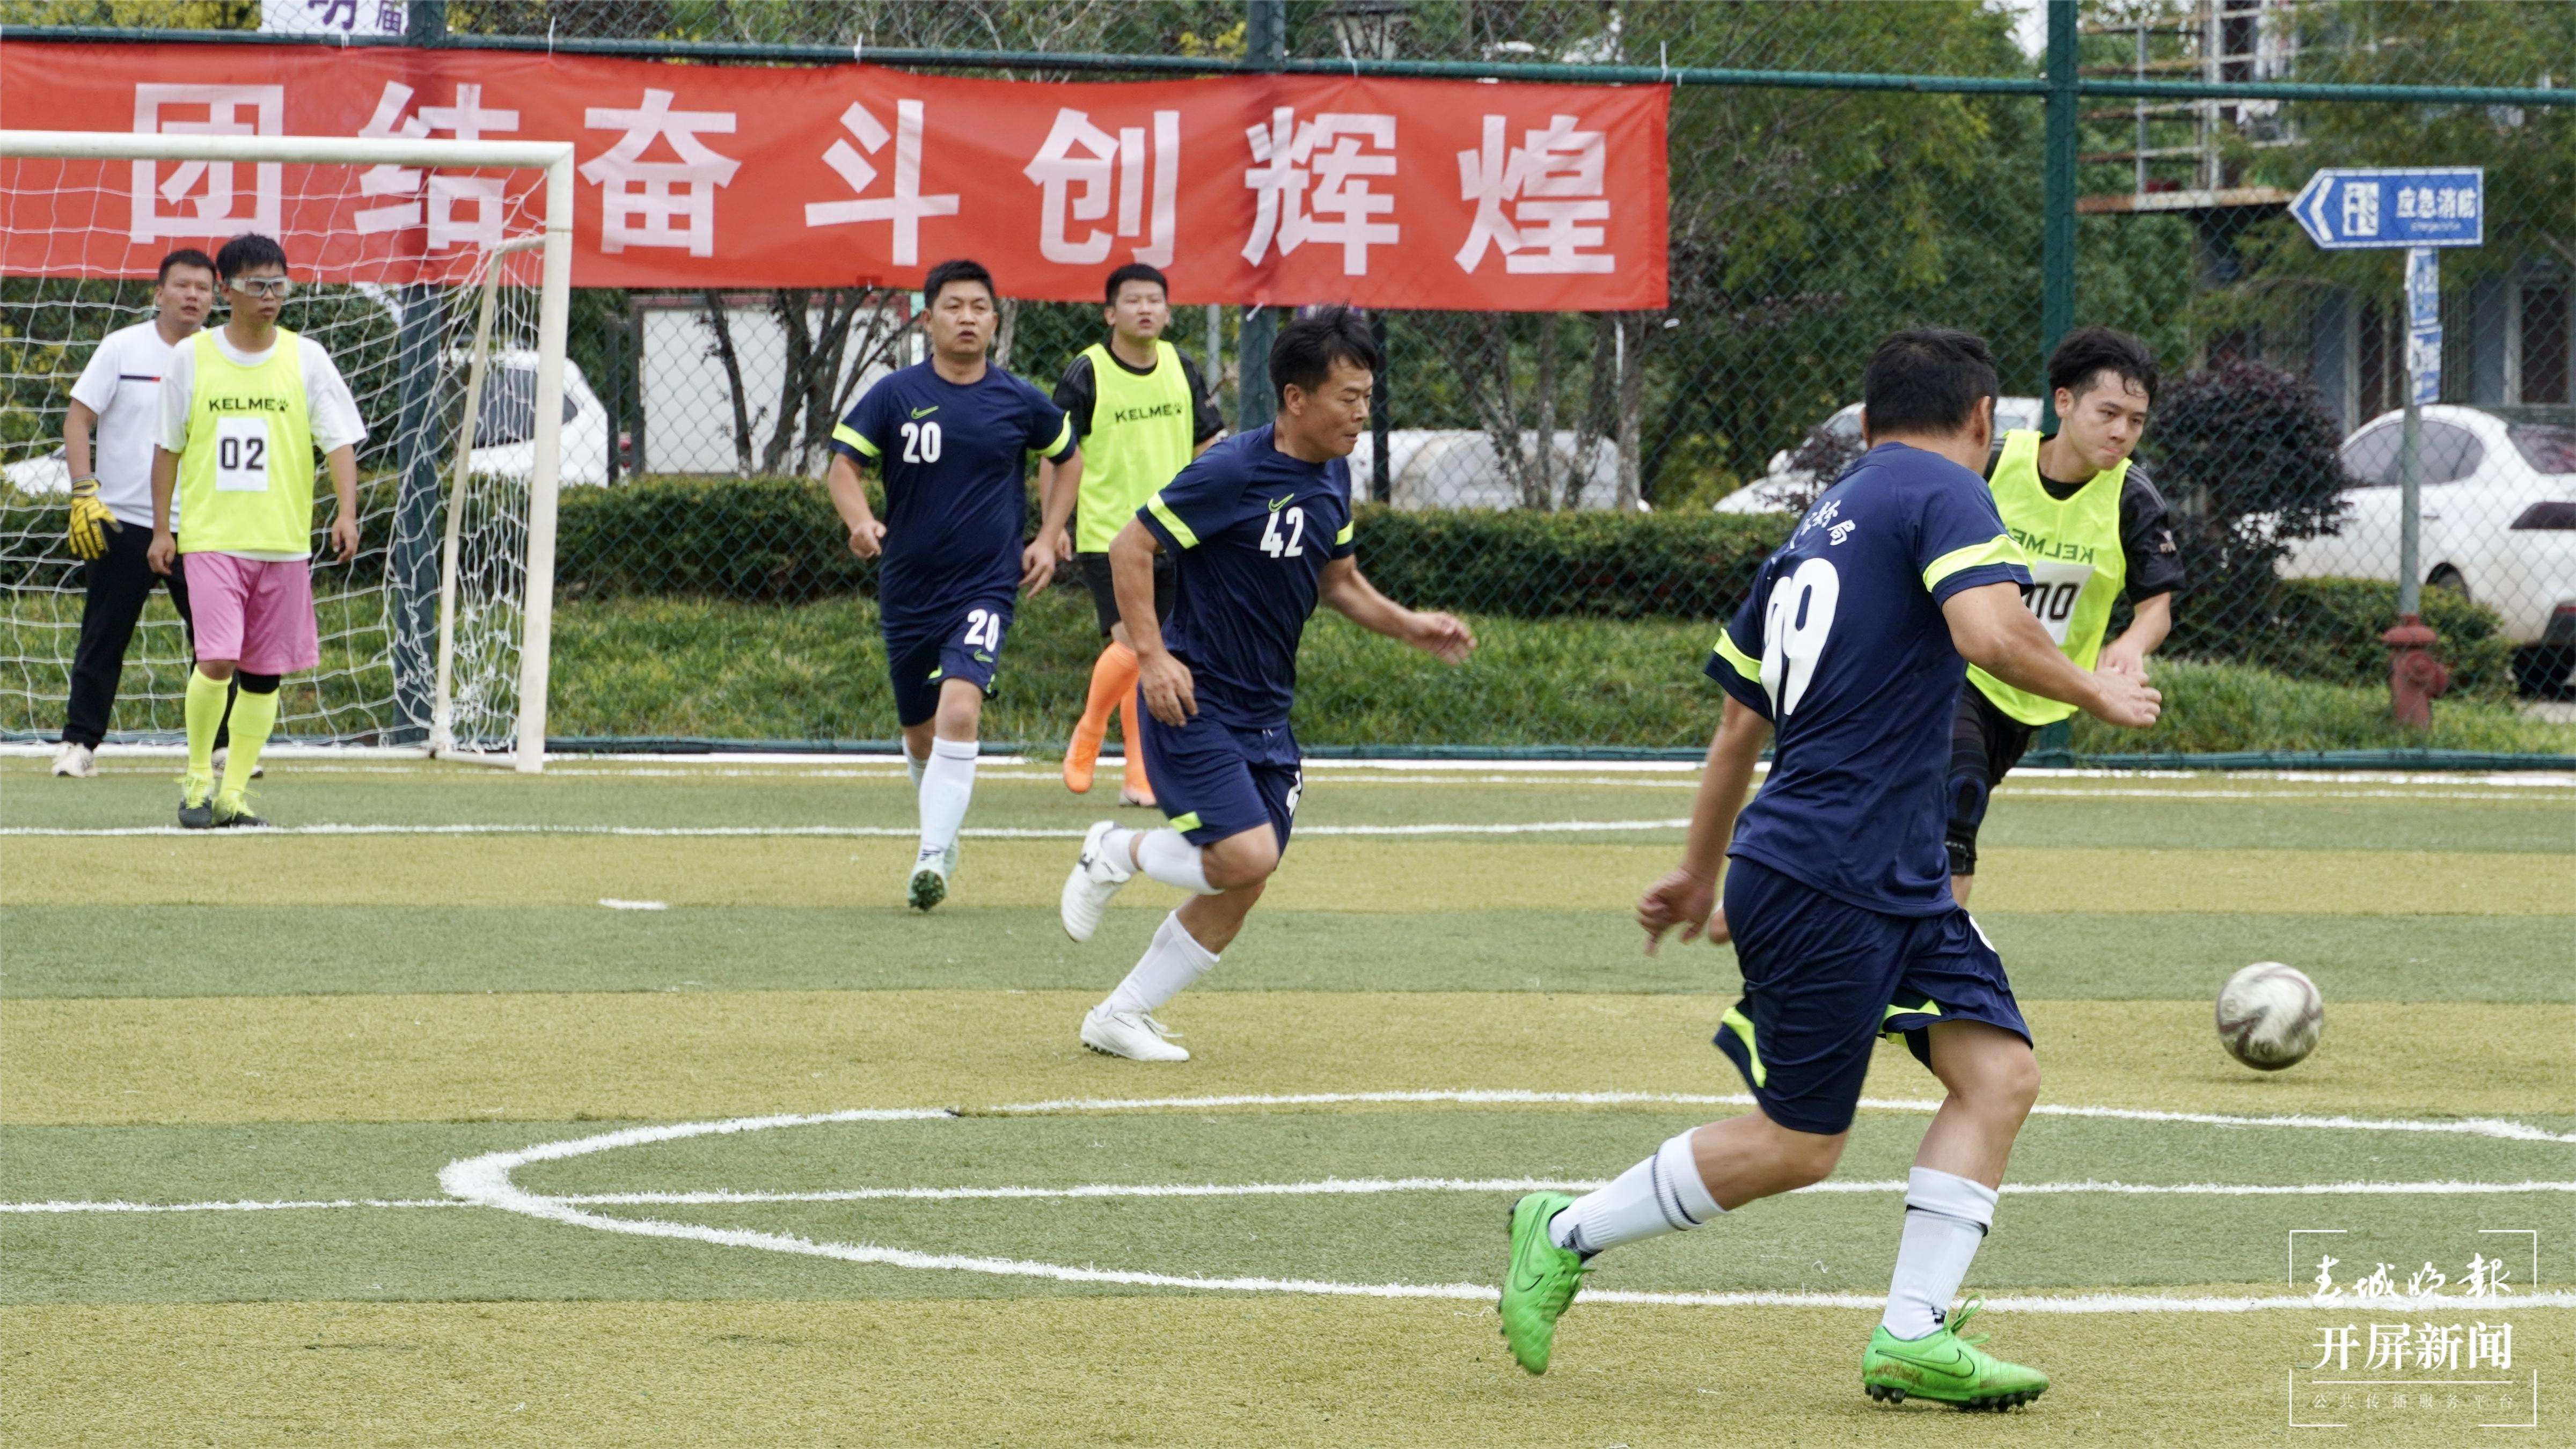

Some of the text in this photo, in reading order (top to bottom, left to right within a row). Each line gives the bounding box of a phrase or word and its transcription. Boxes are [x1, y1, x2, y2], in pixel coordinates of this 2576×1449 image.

[130, 80, 1615, 275] 团结奋斗创辉煌
[2396, 186, 2477, 218] 应急消防
[209, 397, 275, 412] KELME
[1115, 404, 1173, 423] KELME
[221, 436, 264, 471] 02
[901, 421, 941, 463] 20
[1260, 507, 1304, 558] 42
[964, 609, 1000, 652] 20
